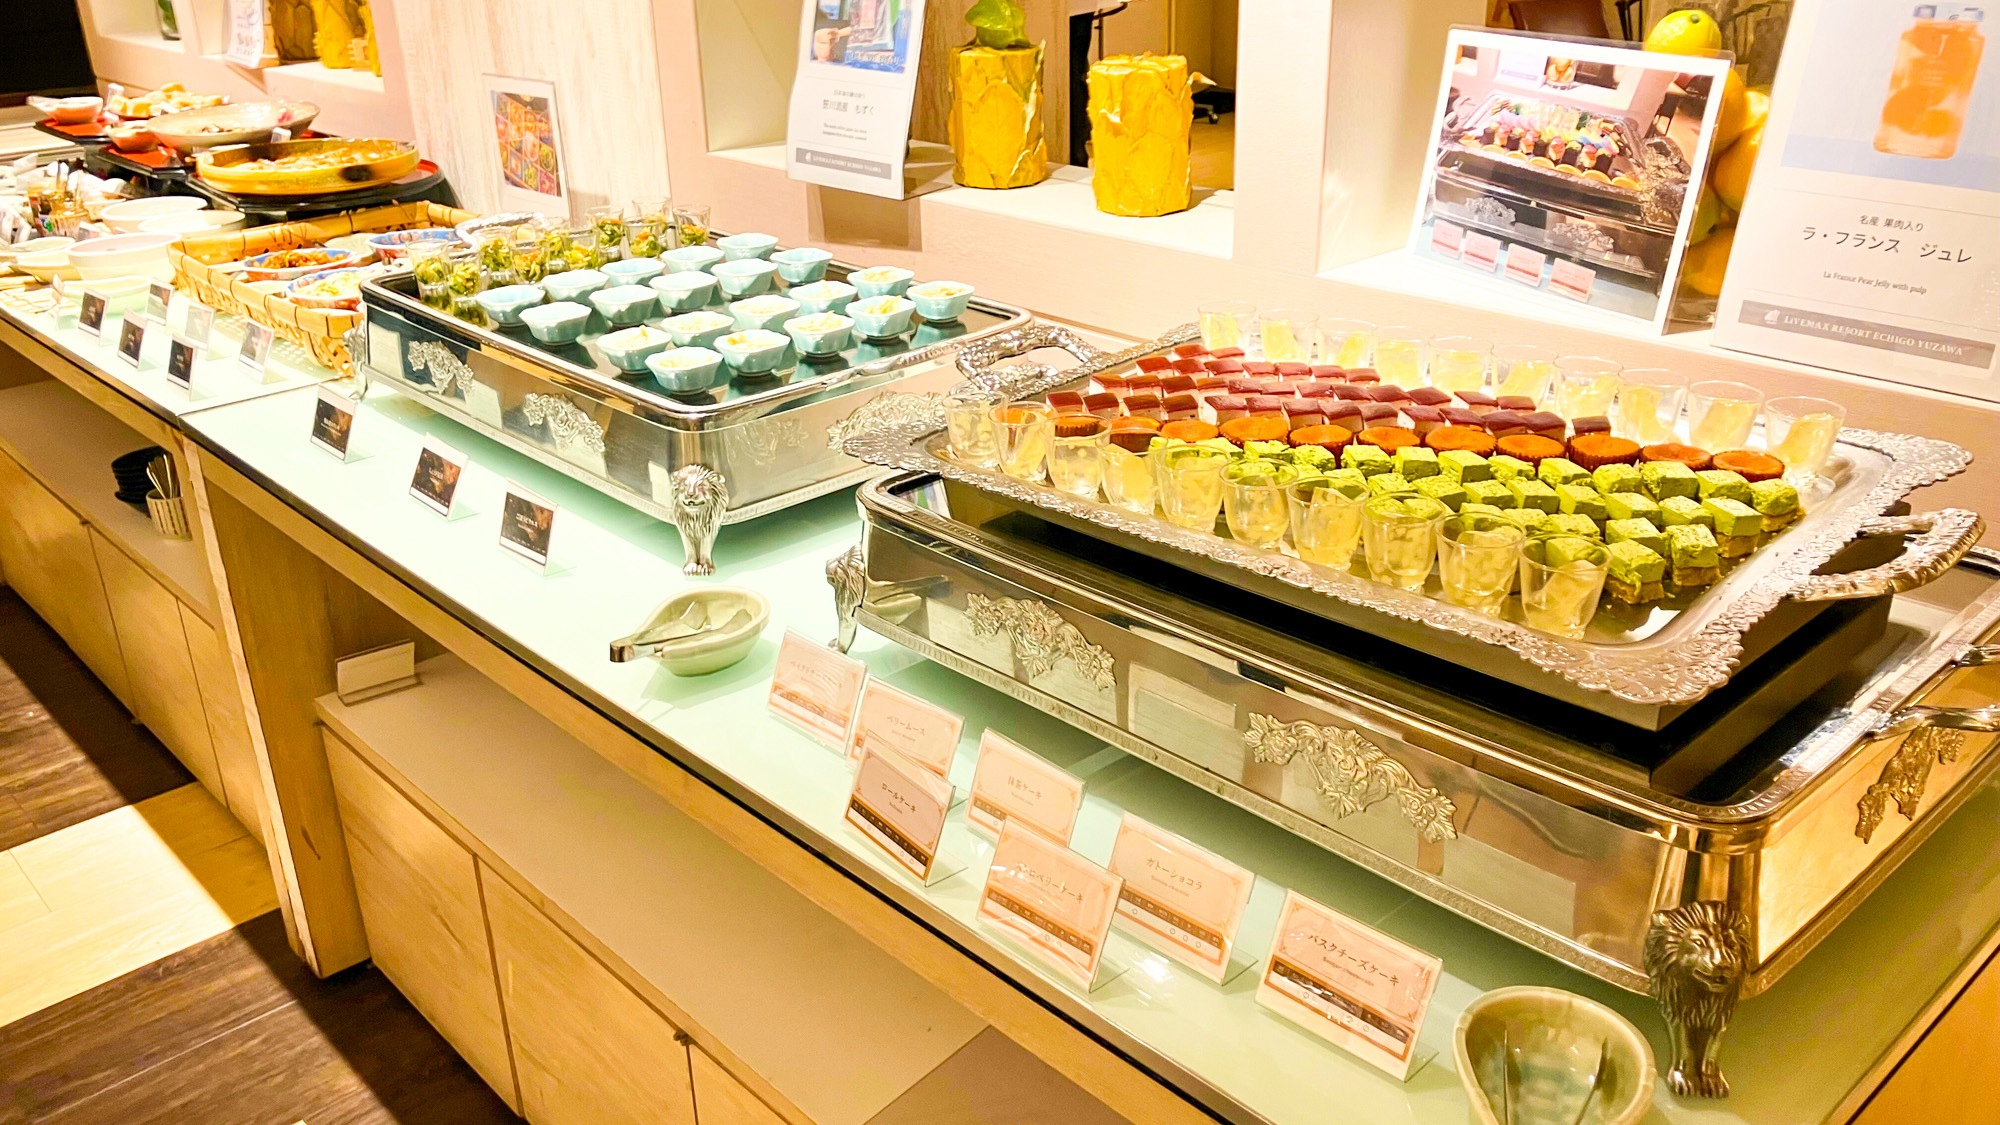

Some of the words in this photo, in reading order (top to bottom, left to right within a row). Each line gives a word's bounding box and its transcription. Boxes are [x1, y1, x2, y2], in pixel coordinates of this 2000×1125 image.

[1859, 214, 1879, 226] 名産
[1883, 218, 1924, 232] 果肉入り
[1803, 226, 1900, 253] ラ・フランス
[1920, 243, 1972, 263] ジュレ
[1833, 272, 1856, 283] France
[1857, 276, 1874, 285] Pear
[1892, 283, 1908, 291] with
[1909, 286, 1928, 295] pulp
[1831, 325, 1872, 338] RESORT
[1872, 331, 1915, 346] ECHIGO
[1917, 340, 1963, 356] YUZAWA
[881, 782, 917, 814] ロールケーキ
[1015, 862, 1084, 904] スロベリーケーキ
[1146, 857, 1203, 891] ガトーショコラ
[1308, 934, 1399, 987] バスクチーズケーキ
